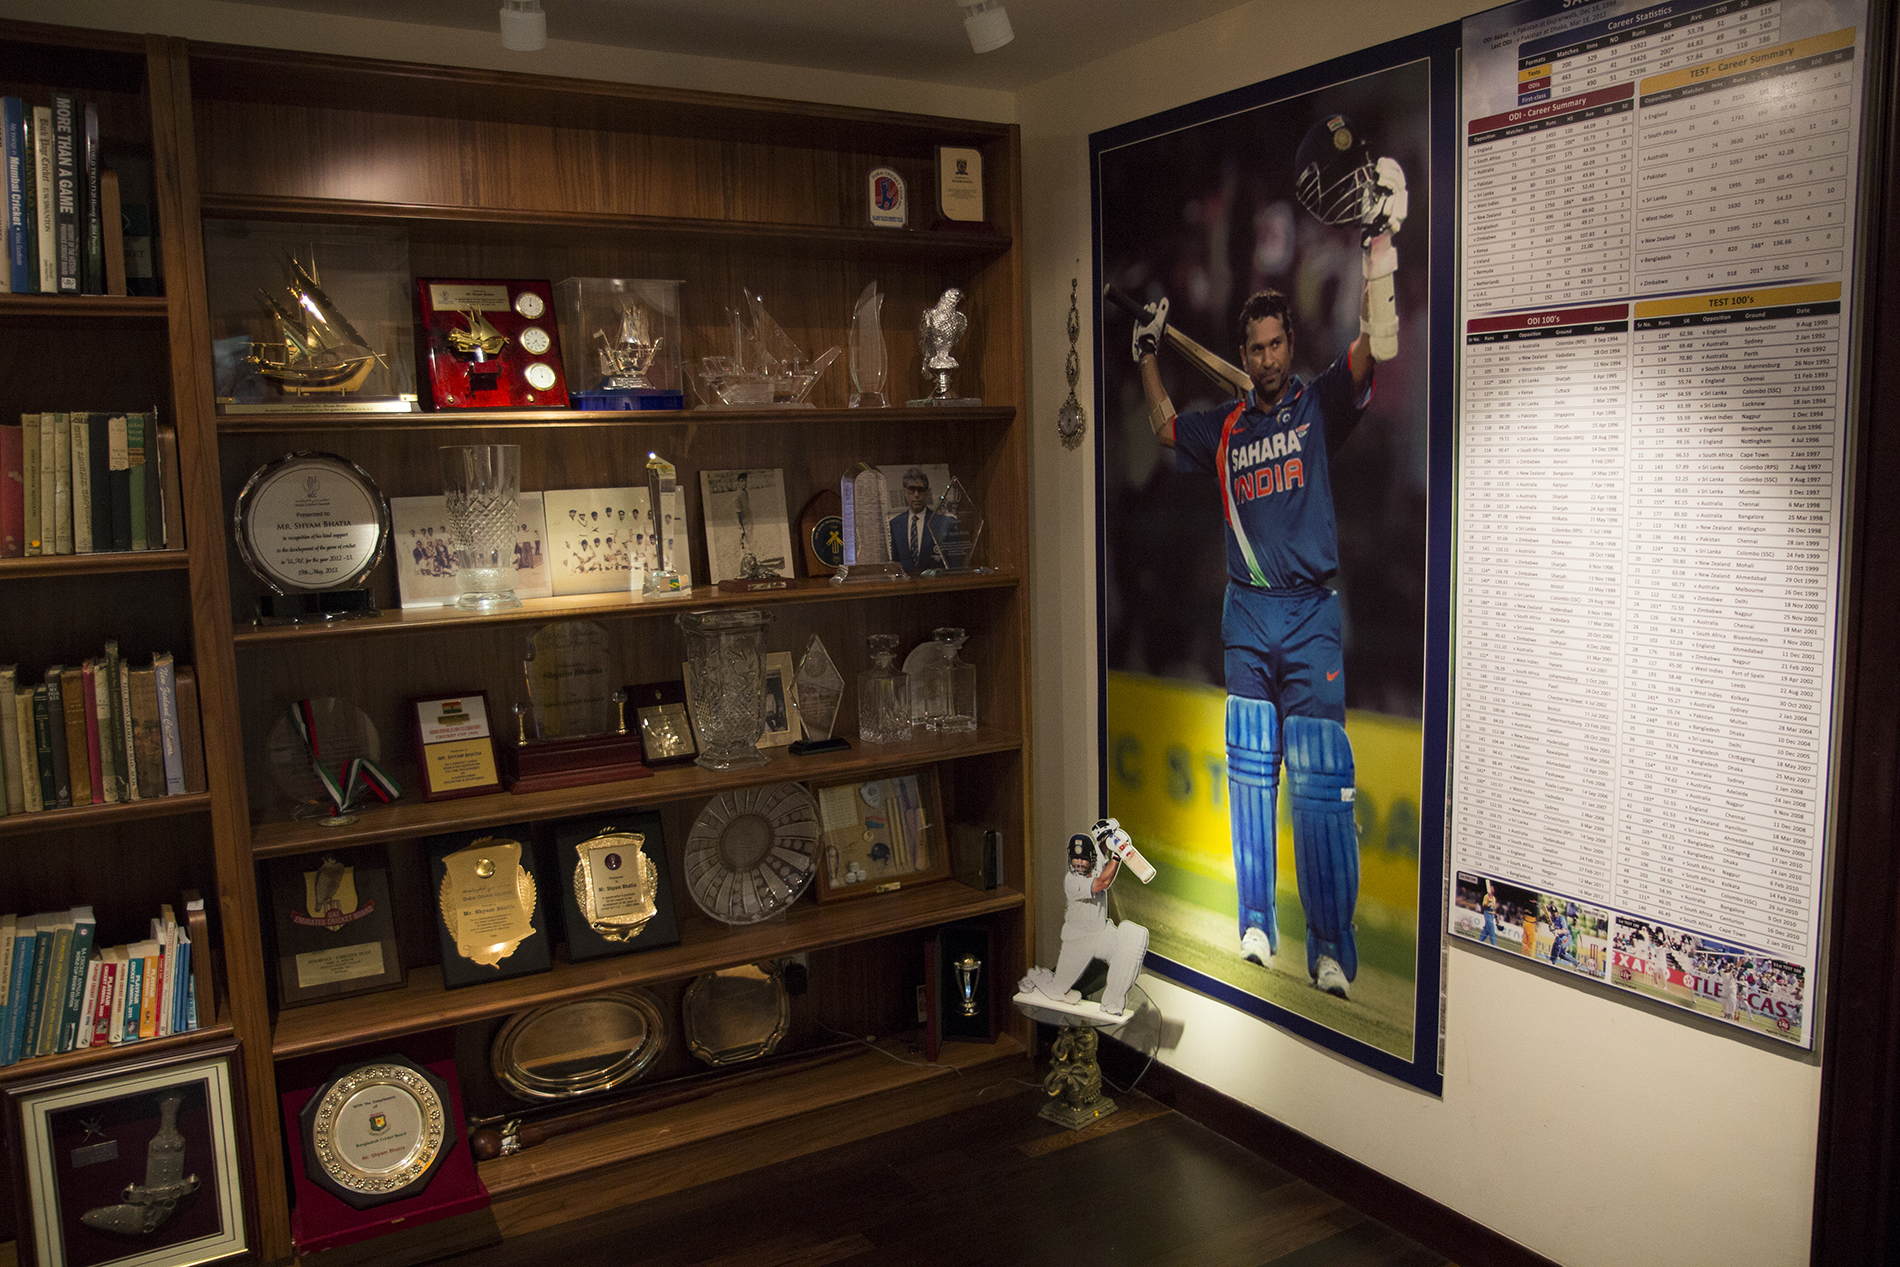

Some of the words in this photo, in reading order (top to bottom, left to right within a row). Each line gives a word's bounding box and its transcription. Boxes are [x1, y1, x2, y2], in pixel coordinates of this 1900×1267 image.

[1608, 18, 1634, 30] Career
[1636, 6, 1672, 21] Statistics
[1556, 47, 1580, 58] Matches
[1632, 28, 1646, 38] Runs
[1690, 66, 1710, 78] TEST
[1718, 59, 1748, 72] Career
[1750, 46, 1794, 64] Summary
[56, 98, 70, 133] MORE
[1508, 113, 1522, 122] ODI
[1528, 106, 1550, 118] Career
[1552, 97, 1587, 112] Summary
[58, 135, 72, 166] THAN
[10, 156, 21, 192] Mumbai
[58, 168, 72, 177] A
[11, 193, 22, 226] Cricket
[59, 180, 74, 214] GAME
[1708, 298, 1728, 307] TEST
[1731, 296, 1754, 306] 100's
[1526, 318, 1540, 326] ODI
[1542, 315, 1560, 324] 100's
[1232, 430, 1302, 472] SAHARA
[1234, 458, 1304, 505] INDIA
[324, 520, 352, 528] BHATIA
[159, 668, 170, 684] New
[160, 686, 171, 716] Zealand
[328, 914, 352, 925] CRICKET
[104, 976, 113, 1006] PLAYFAIR
